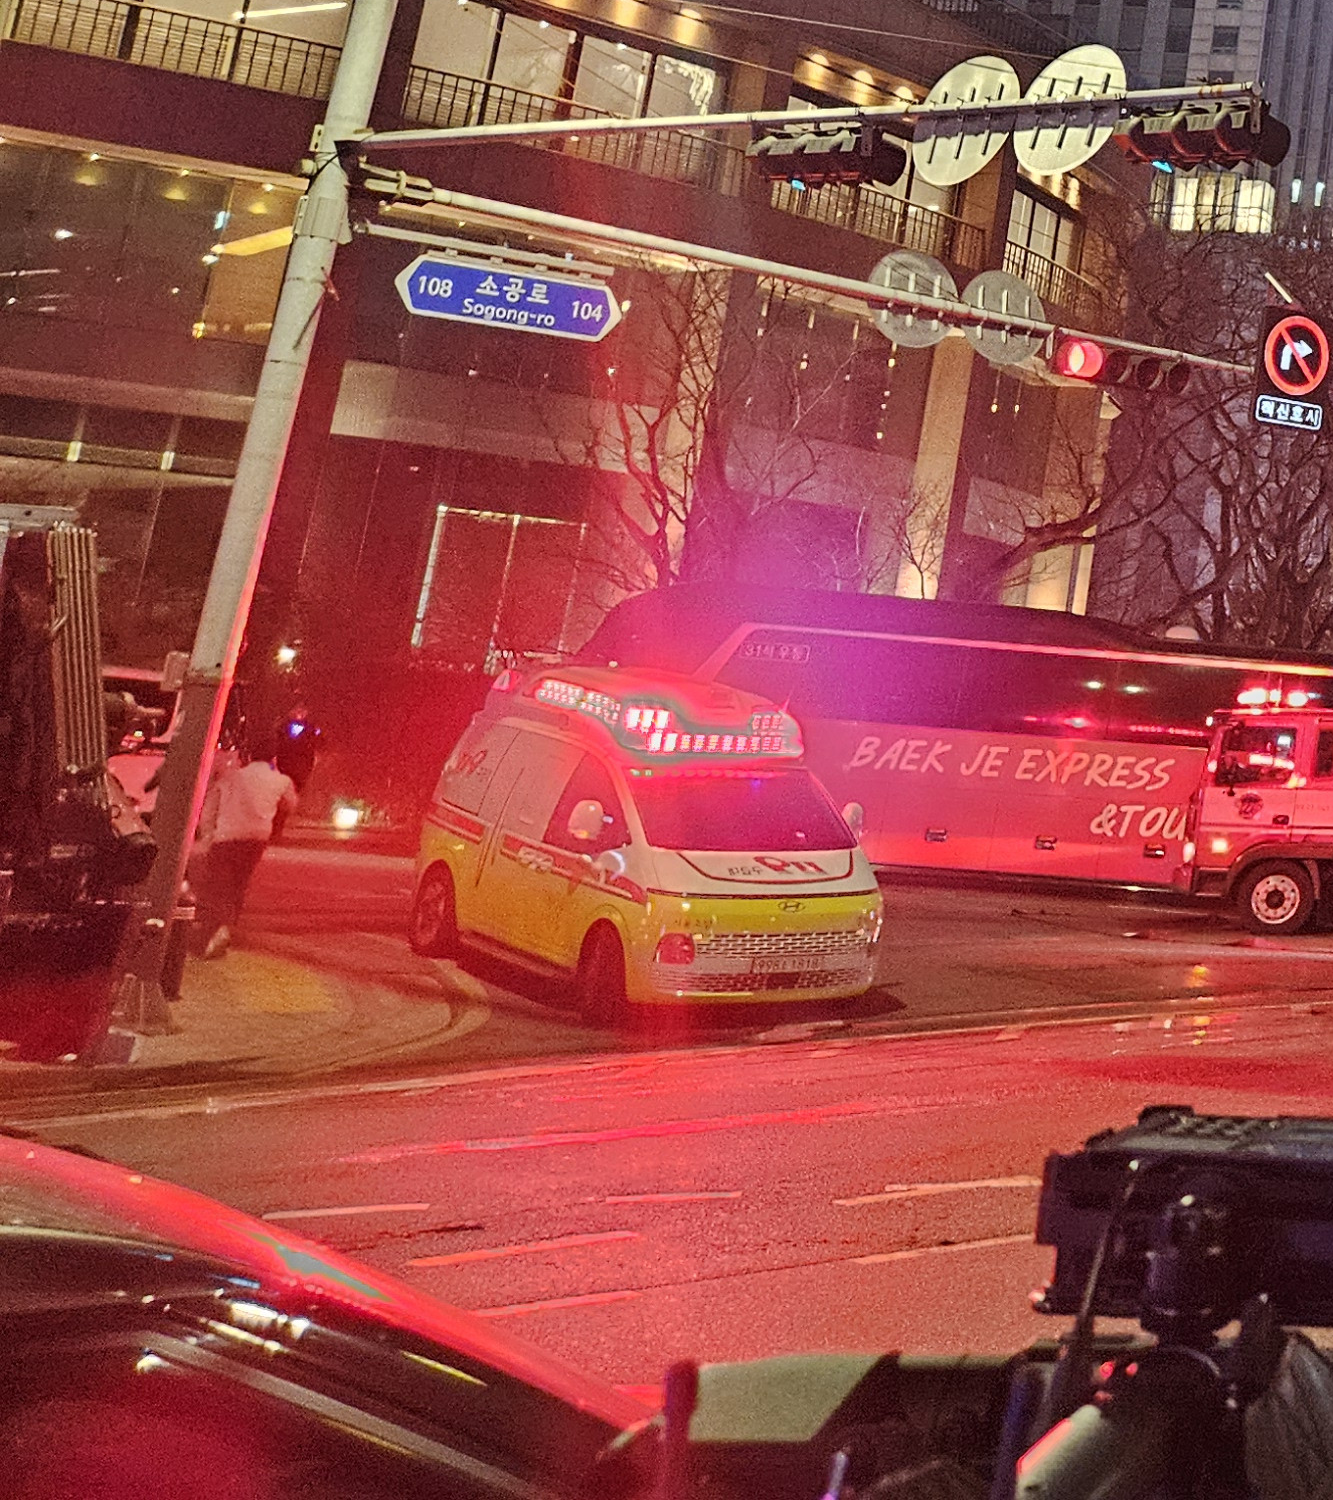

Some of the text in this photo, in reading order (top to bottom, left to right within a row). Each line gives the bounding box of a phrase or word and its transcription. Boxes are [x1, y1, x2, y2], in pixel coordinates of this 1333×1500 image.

[416, 274, 454, 298] 108
[475, 274, 551, 306] 소공로
[462, 297, 556, 327] Sogong-ro
[571, 299, 604, 323] 104
[847, 734, 1177, 791] BAEK JE EXPRESS
